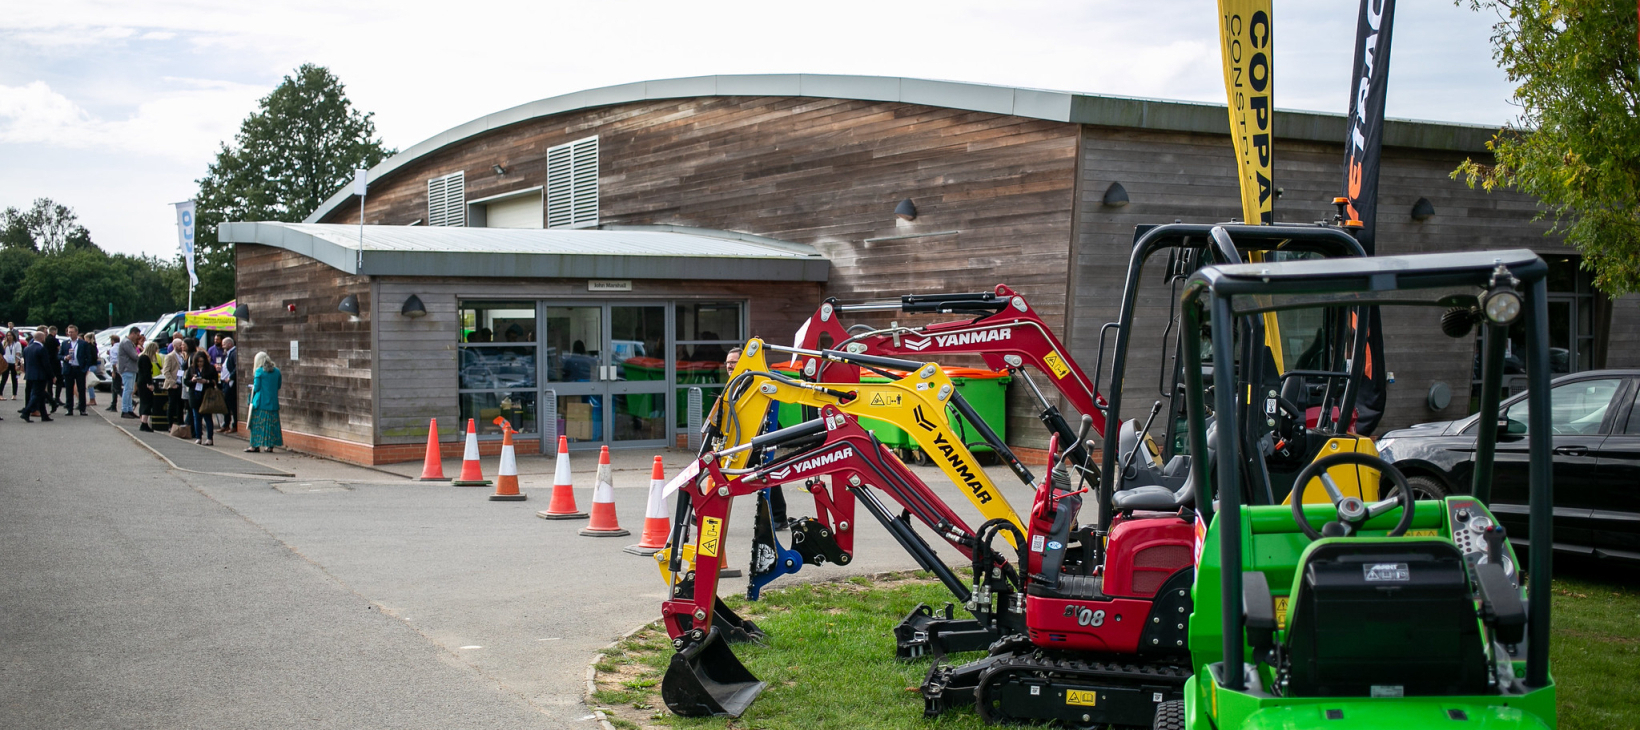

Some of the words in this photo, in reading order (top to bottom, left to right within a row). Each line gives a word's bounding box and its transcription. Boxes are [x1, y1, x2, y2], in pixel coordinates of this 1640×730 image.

[935, 328, 1011, 347] YANMAR
[793, 447, 853, 473] YANMAR
[933, 432, 992, 504] YANMAR
